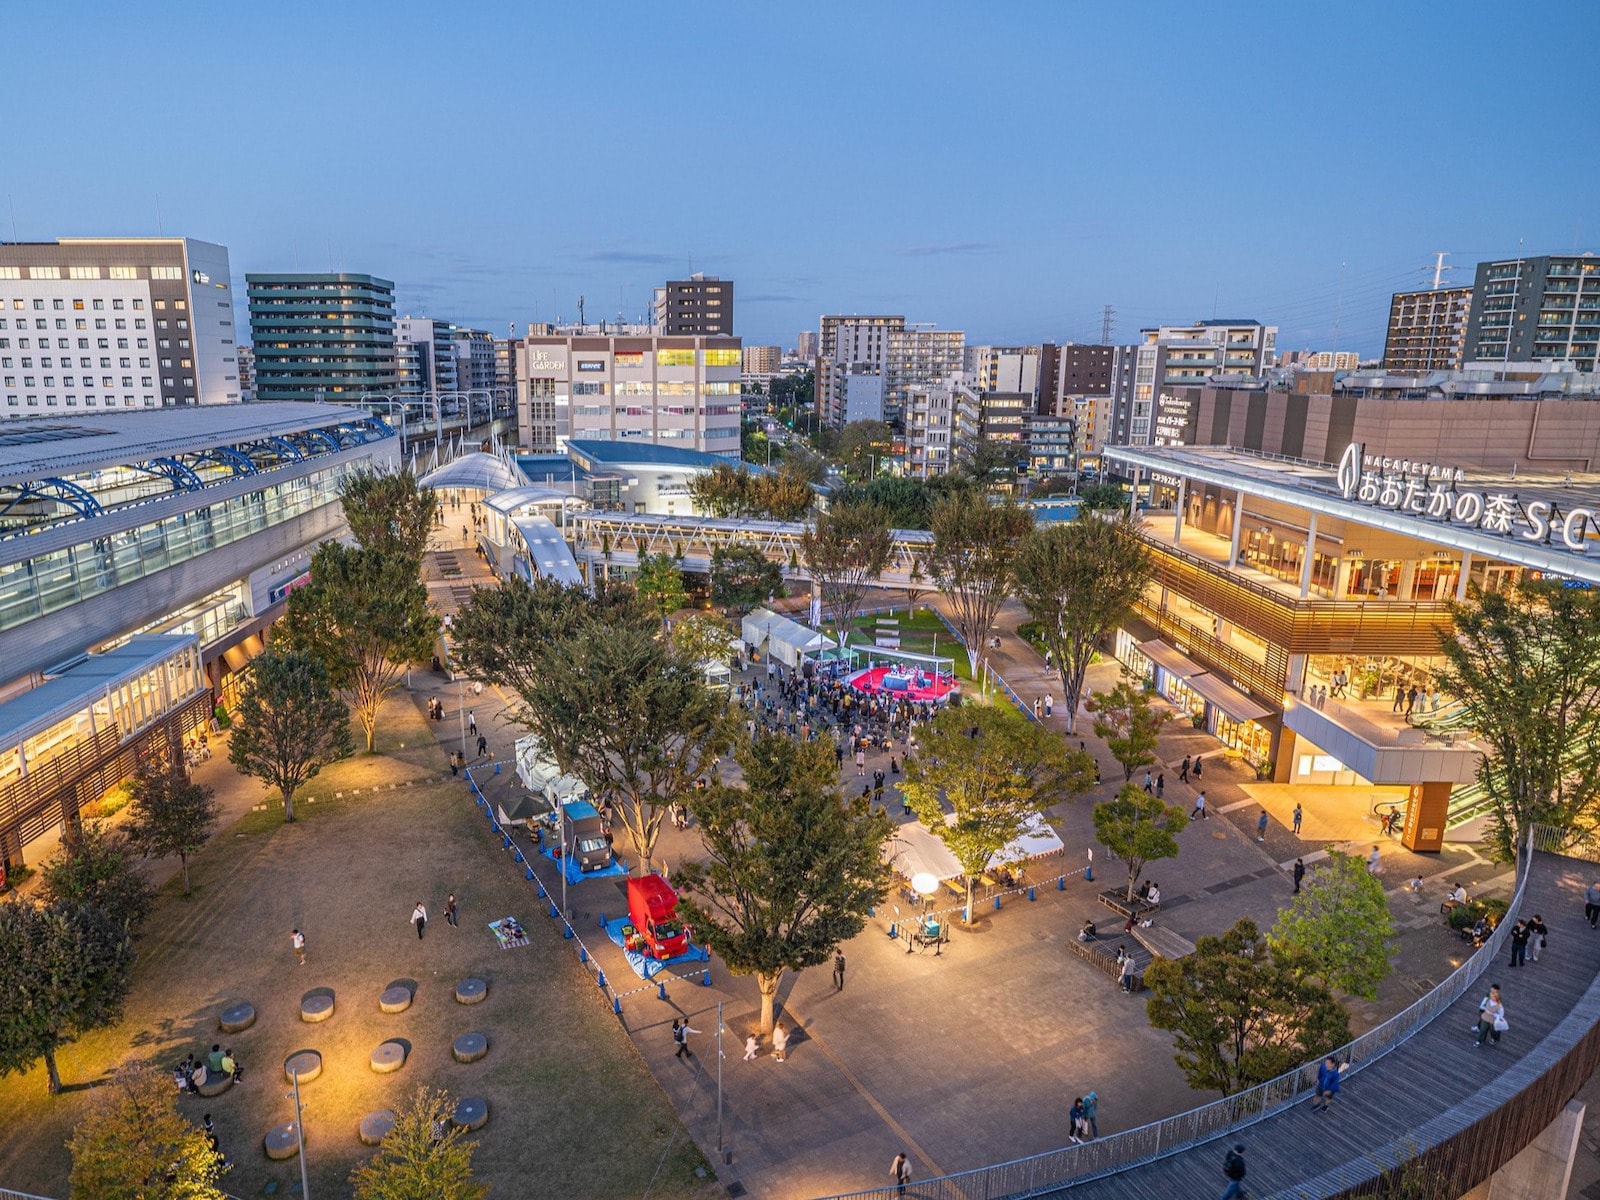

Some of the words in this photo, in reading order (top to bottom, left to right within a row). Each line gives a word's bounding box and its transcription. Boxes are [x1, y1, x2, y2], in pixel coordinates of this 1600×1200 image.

[533, 350, 549, 361] LIFE
[532, 361, 565, 370] GARDEN
[1365, 455, 1465, 482] NAGAREYAMA
[1359, 471, 1514, 532] おおたかの森
